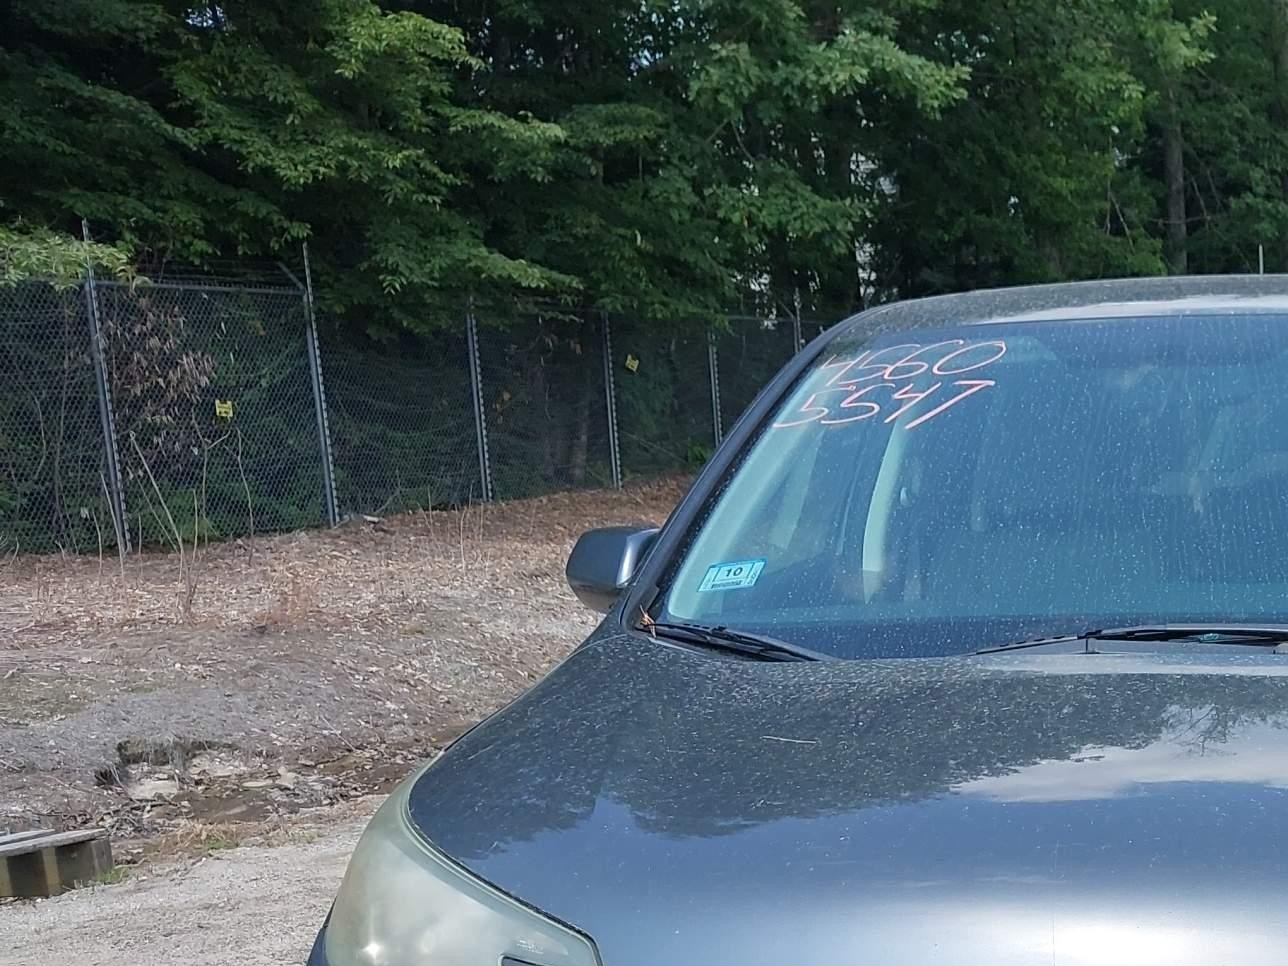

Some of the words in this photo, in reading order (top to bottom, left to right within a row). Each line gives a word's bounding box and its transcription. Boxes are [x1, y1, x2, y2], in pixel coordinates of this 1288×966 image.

[821, 339, 1007, 387] 4560
[772, 380, 996, 430] 5547
[725, 567, 743, 577] 10
